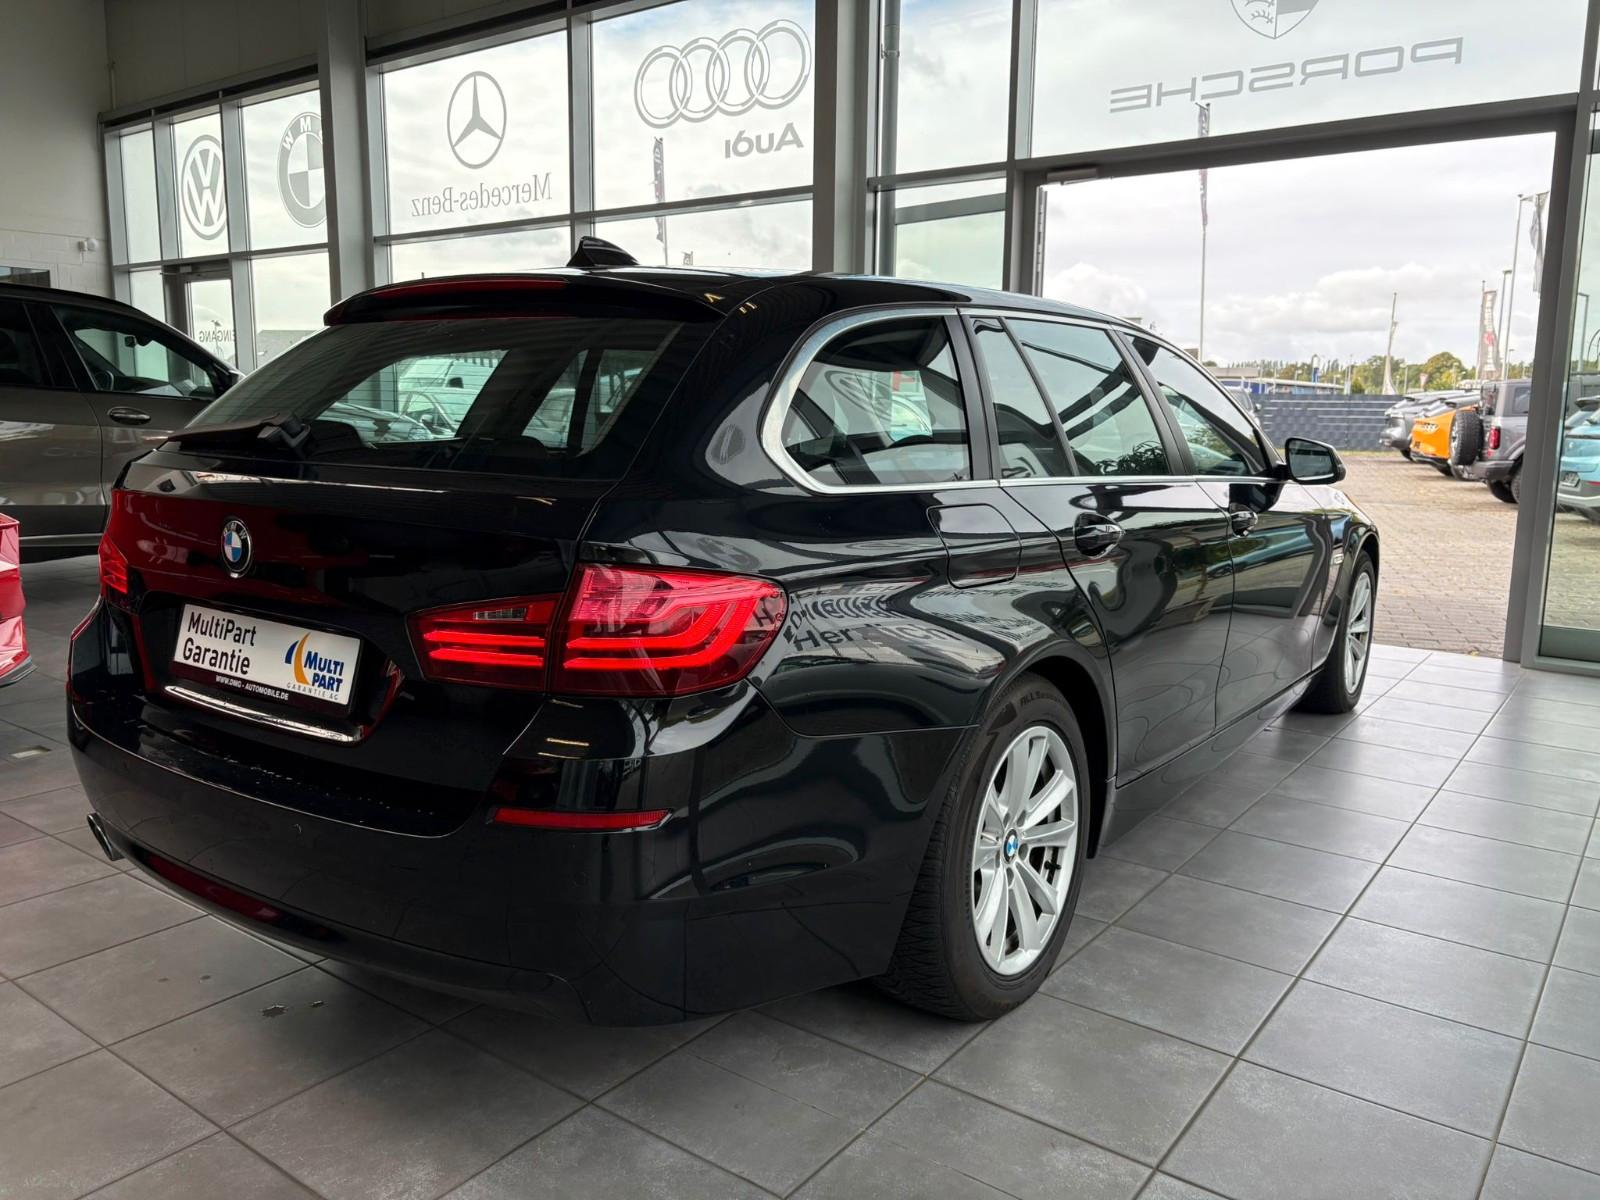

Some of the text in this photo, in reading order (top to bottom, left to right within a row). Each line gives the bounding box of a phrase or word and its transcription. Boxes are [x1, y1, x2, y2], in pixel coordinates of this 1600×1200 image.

[187, 611, 257, 647] MultiPart
[182, 637, 250, 675] Garantie
[311, 672, 344, 693] PART
